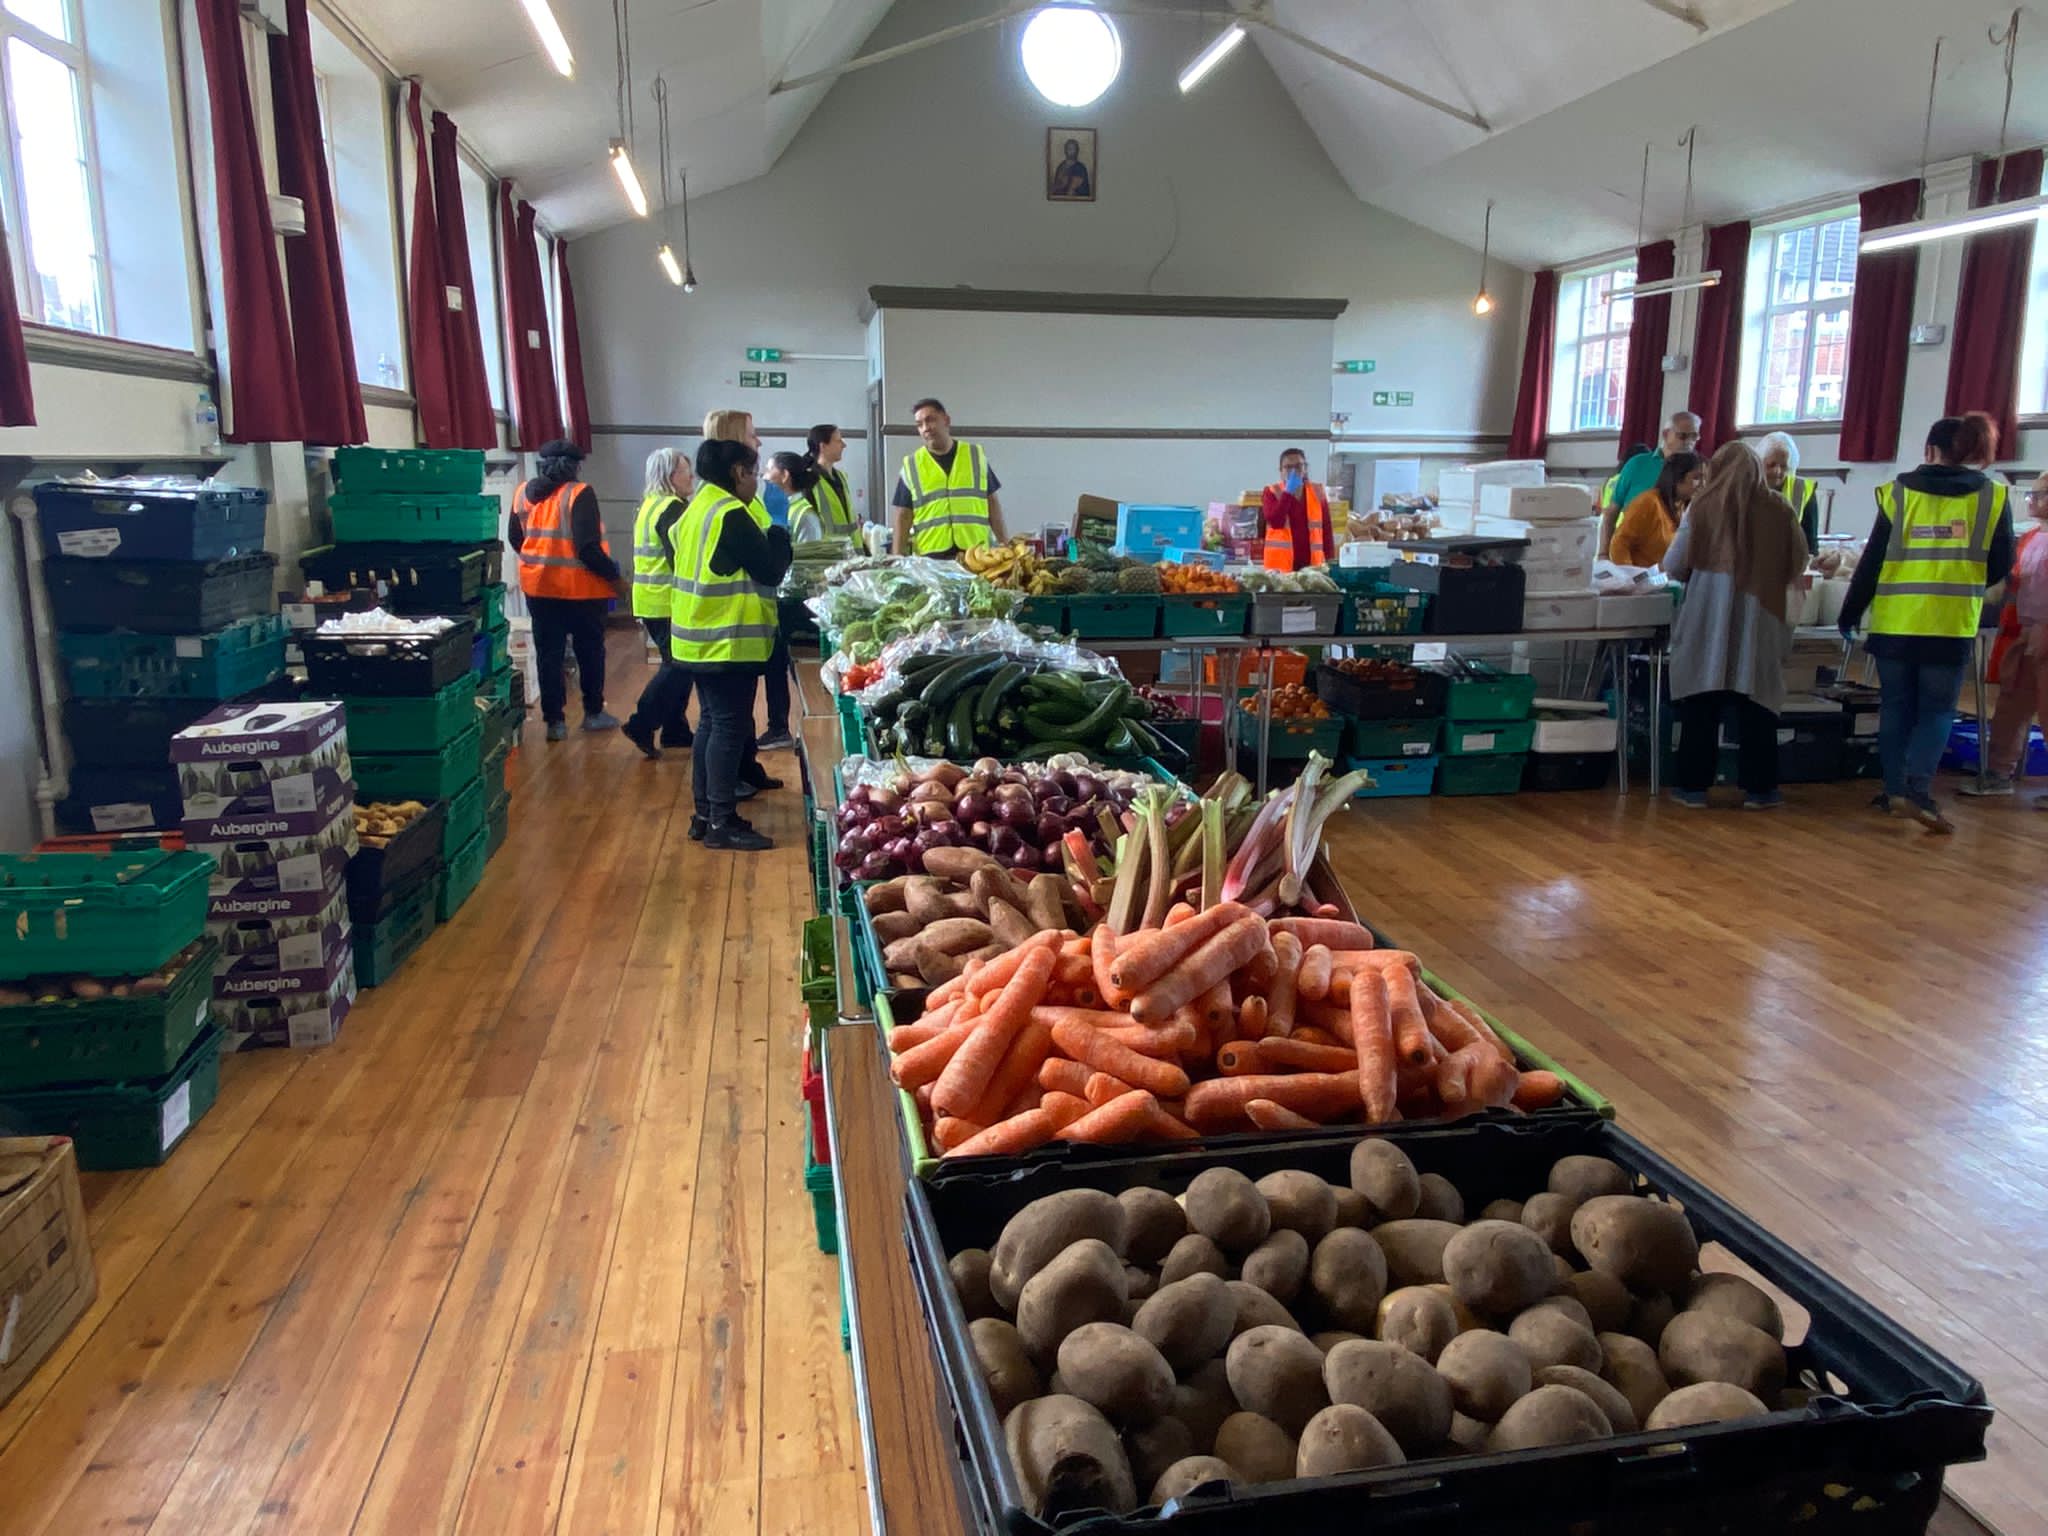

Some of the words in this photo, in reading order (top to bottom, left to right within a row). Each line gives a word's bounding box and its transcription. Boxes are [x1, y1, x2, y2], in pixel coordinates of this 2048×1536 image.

[201, 738, 281, 755] Aubergine
[210, 820, 289, 836] Aubergine
[211, 898, 291, 914] Aubergine
[223, 976, 301, 993] Aubergine
